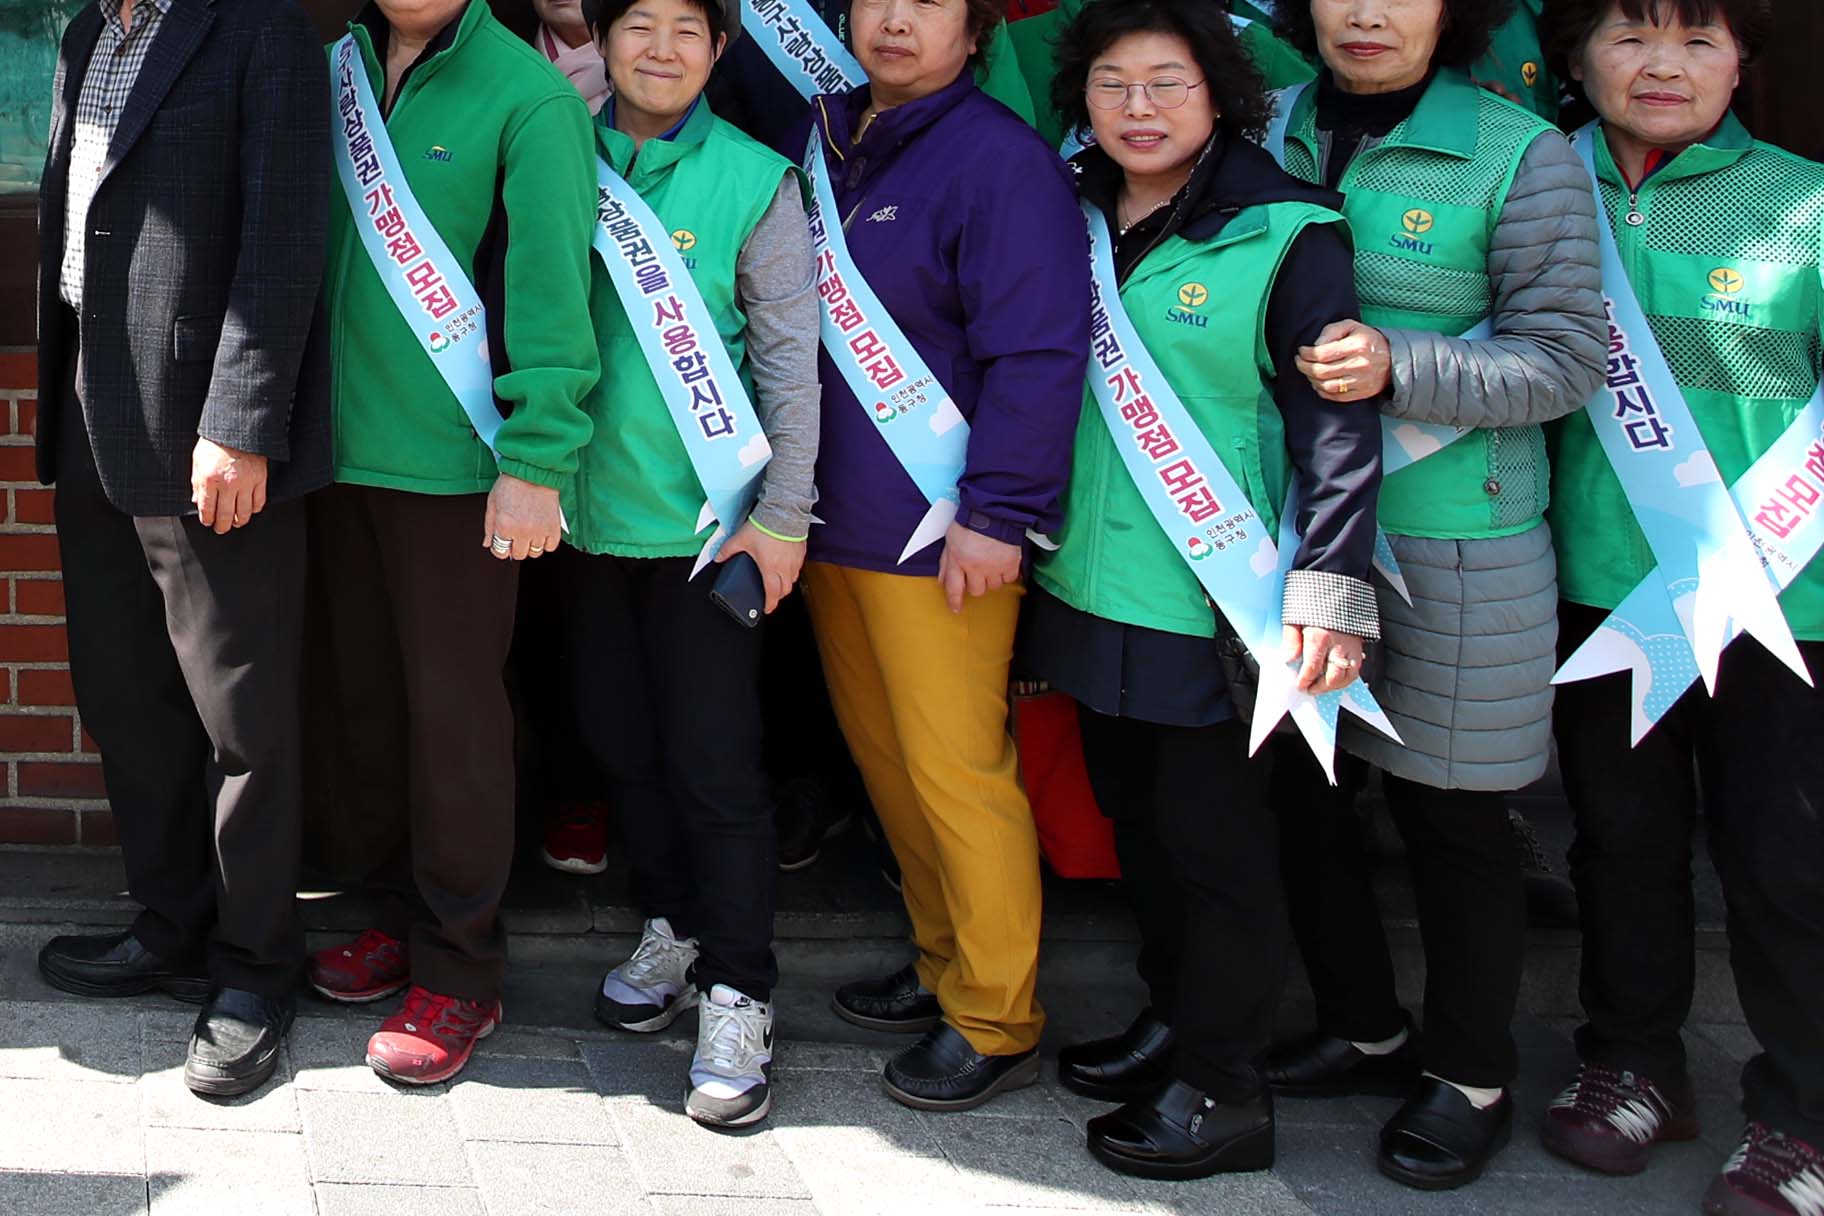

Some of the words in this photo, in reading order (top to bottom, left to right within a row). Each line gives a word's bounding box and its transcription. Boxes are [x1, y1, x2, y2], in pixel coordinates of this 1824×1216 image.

[421, 150, 453, 163] SMU
[337, 37, 383, 187] 동구사랑상품권
[364, 183, 422, 265] 가맹점
[404, 257, 458, 320] 모집
[1388, 233, 1433, 256] SMU
[445, 304, 484, 333] 인천광역시
[816, 249, 865, 329] 가맹점
[848, 330, 905, 390] 모집
[1165, 307, 1209, 329] SMU
[1699, 295, 1750, 317] SMU
[654, 295, 735, 440] 사용합시다
[890, 375, 934, 404] 인천광역시
[1107, 367, 1182, 463] 가맹점
[1157, 458, 1222, 524] 모집
[1753, 474, 1821, 540] 모집
[1206, 508, 1255, 540] 인천광역시
[1214, 528, 1248, 551] 동구청
